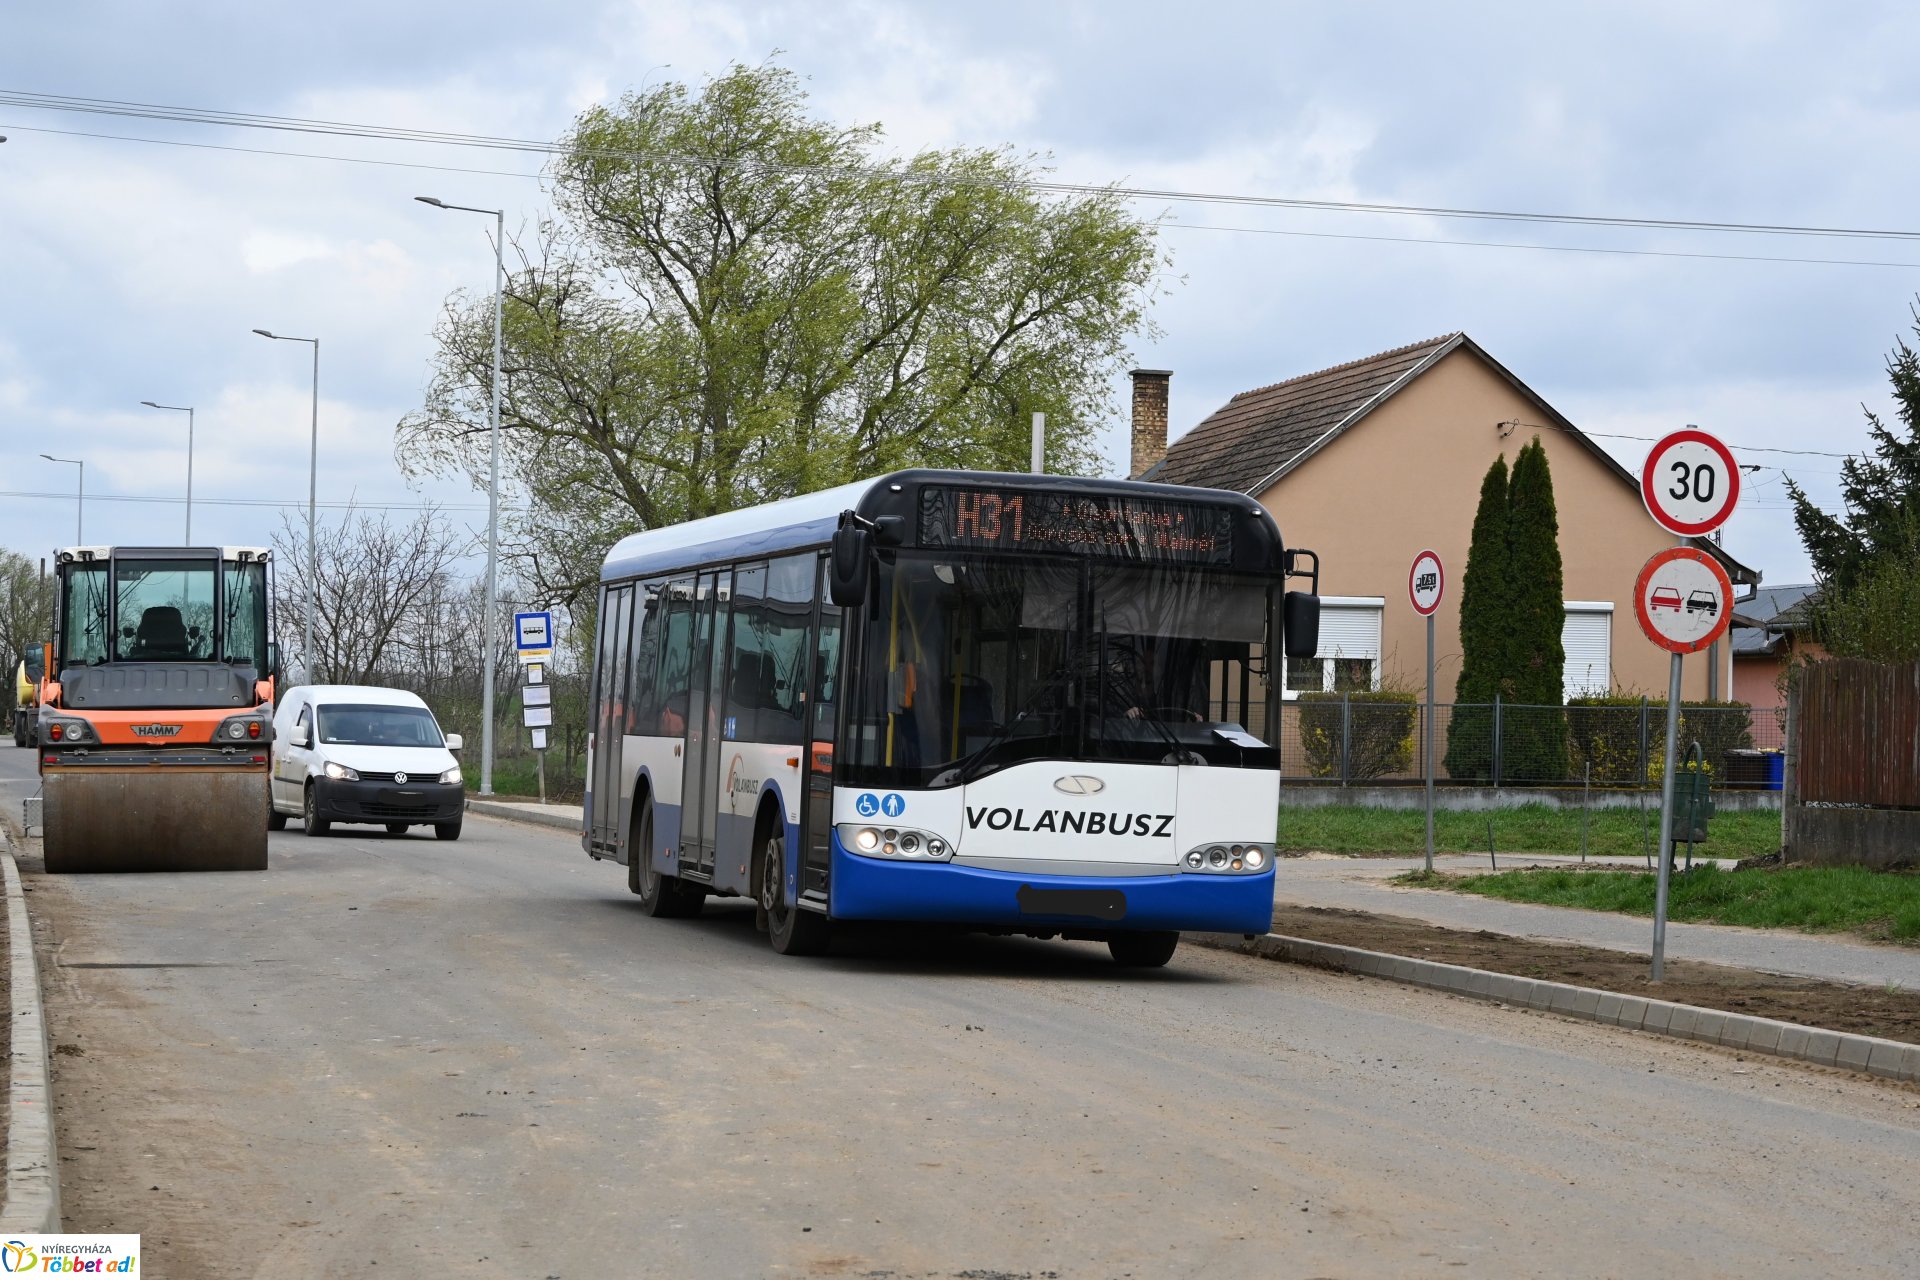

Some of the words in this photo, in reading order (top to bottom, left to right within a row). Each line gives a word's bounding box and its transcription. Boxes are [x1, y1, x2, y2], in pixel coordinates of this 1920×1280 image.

[1668, 461, 1716, 503] 30
[957, 492, 1024, 541] H31
[138, 726, 174, 735] HAMM
[966, 806, 1175, 838] VOLÁNBUSZ
